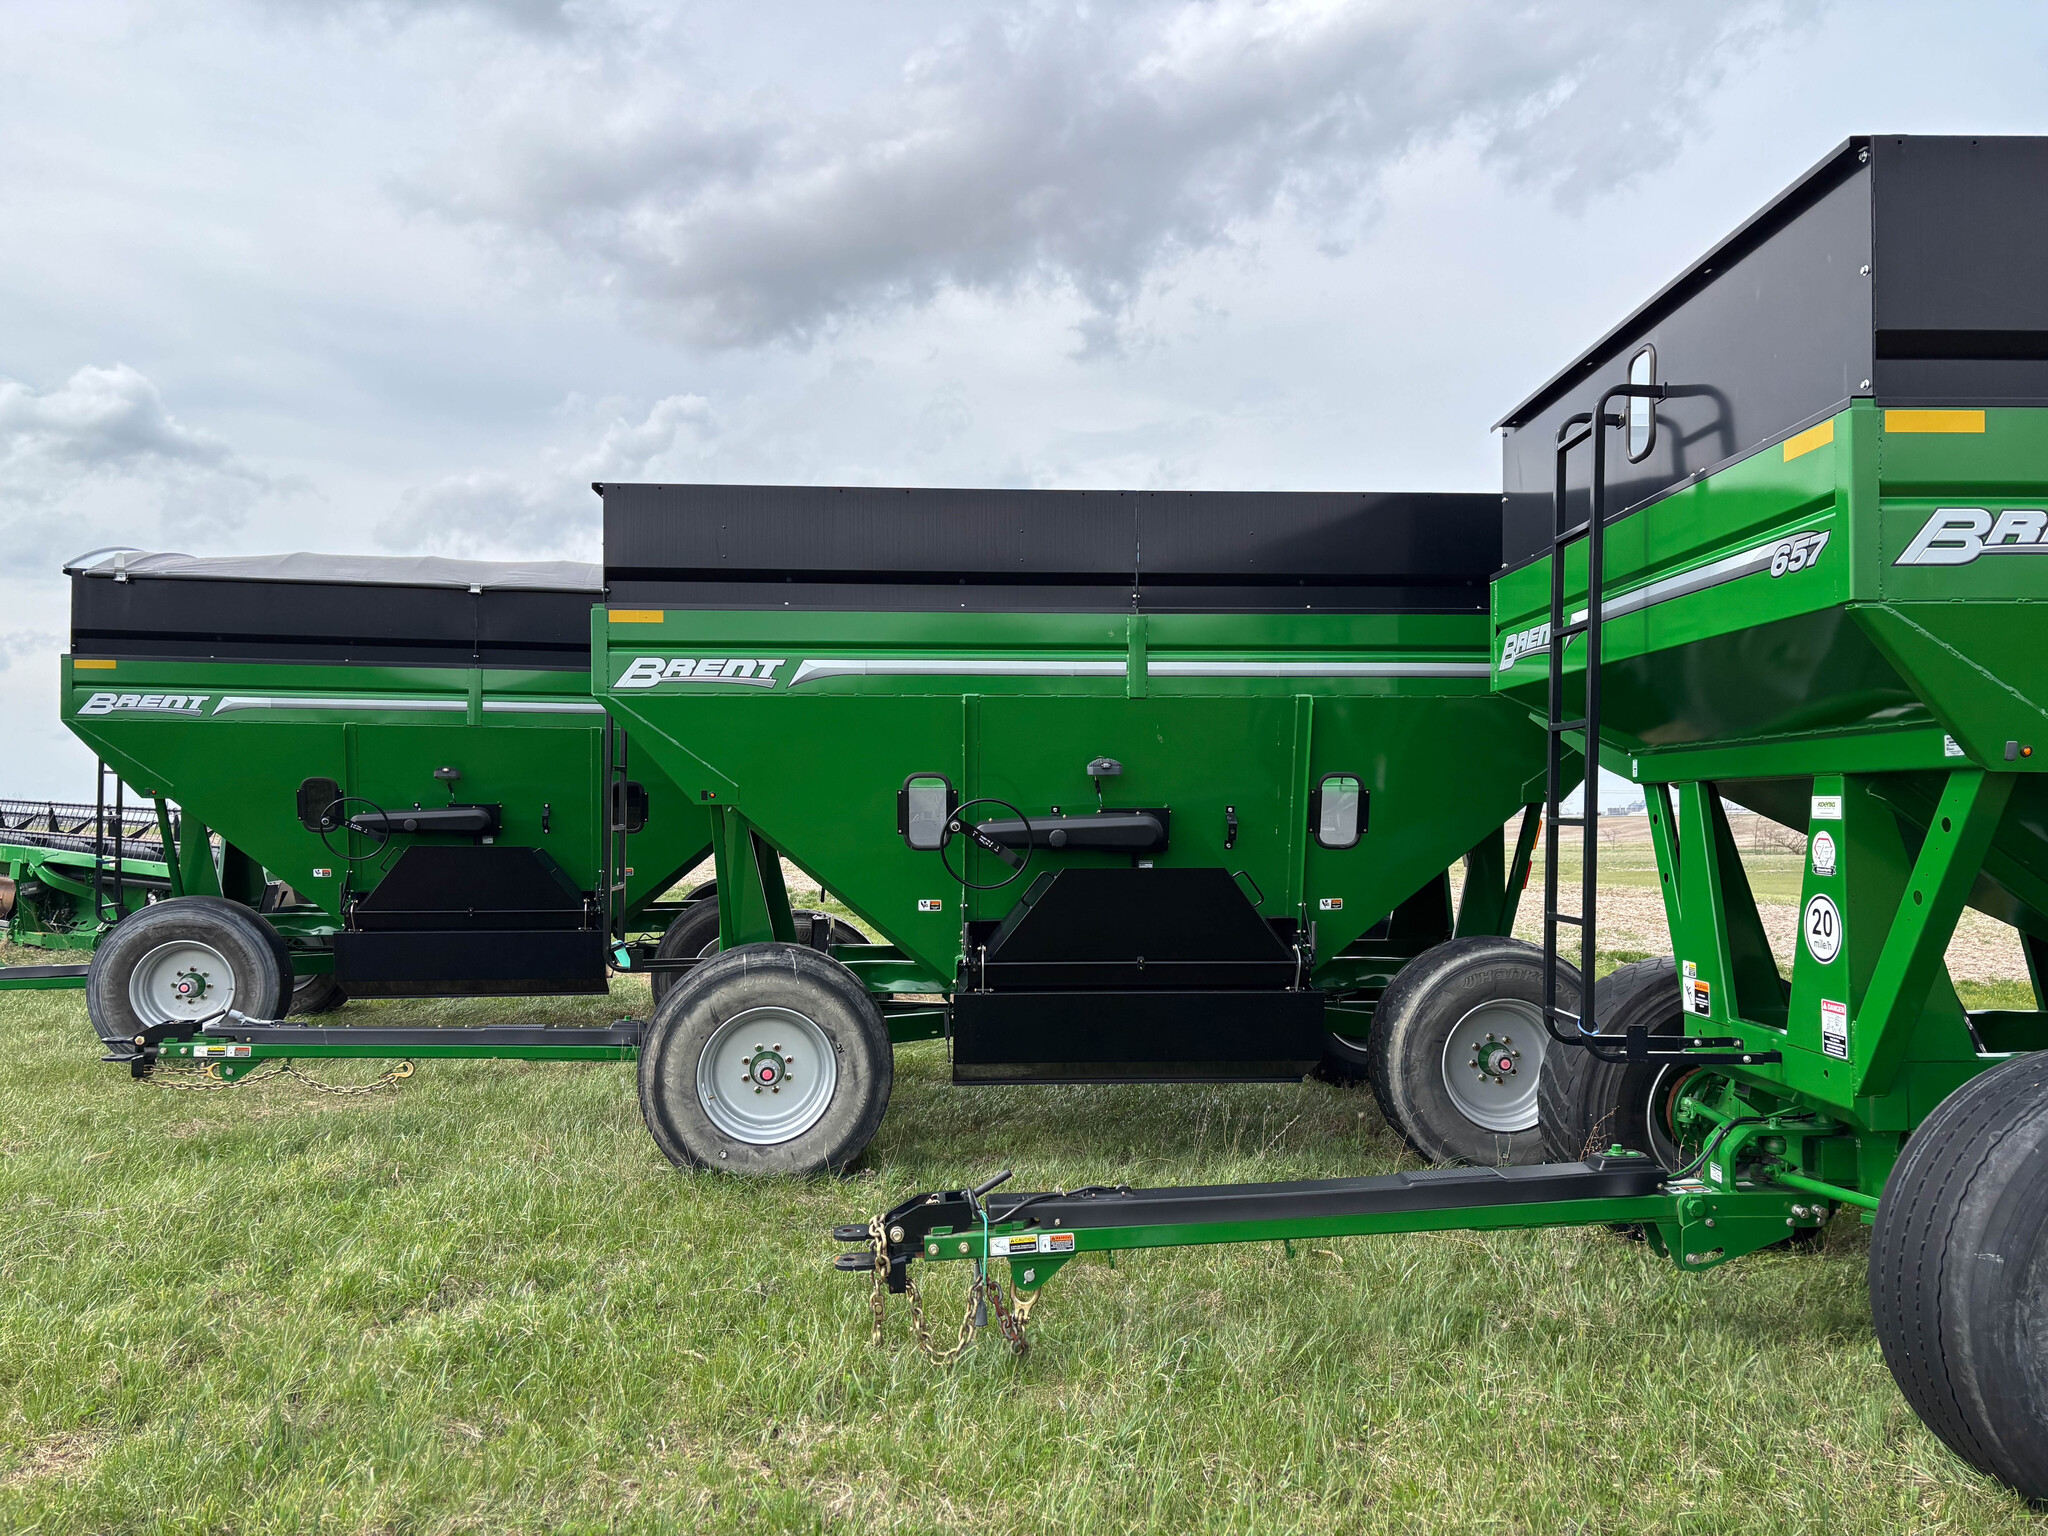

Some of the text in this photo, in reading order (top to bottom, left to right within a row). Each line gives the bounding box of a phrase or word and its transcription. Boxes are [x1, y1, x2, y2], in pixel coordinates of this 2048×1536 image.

[1771, 530, 1831, 578] 657
[1891, 507, 2048, 566] BR
[1498, 620, 1558, 672] BREN
[611, 657, 787, 689] BRENT
[76, 692, 210, 716] BRENT
[1812, 908, 1833, 938] 20
